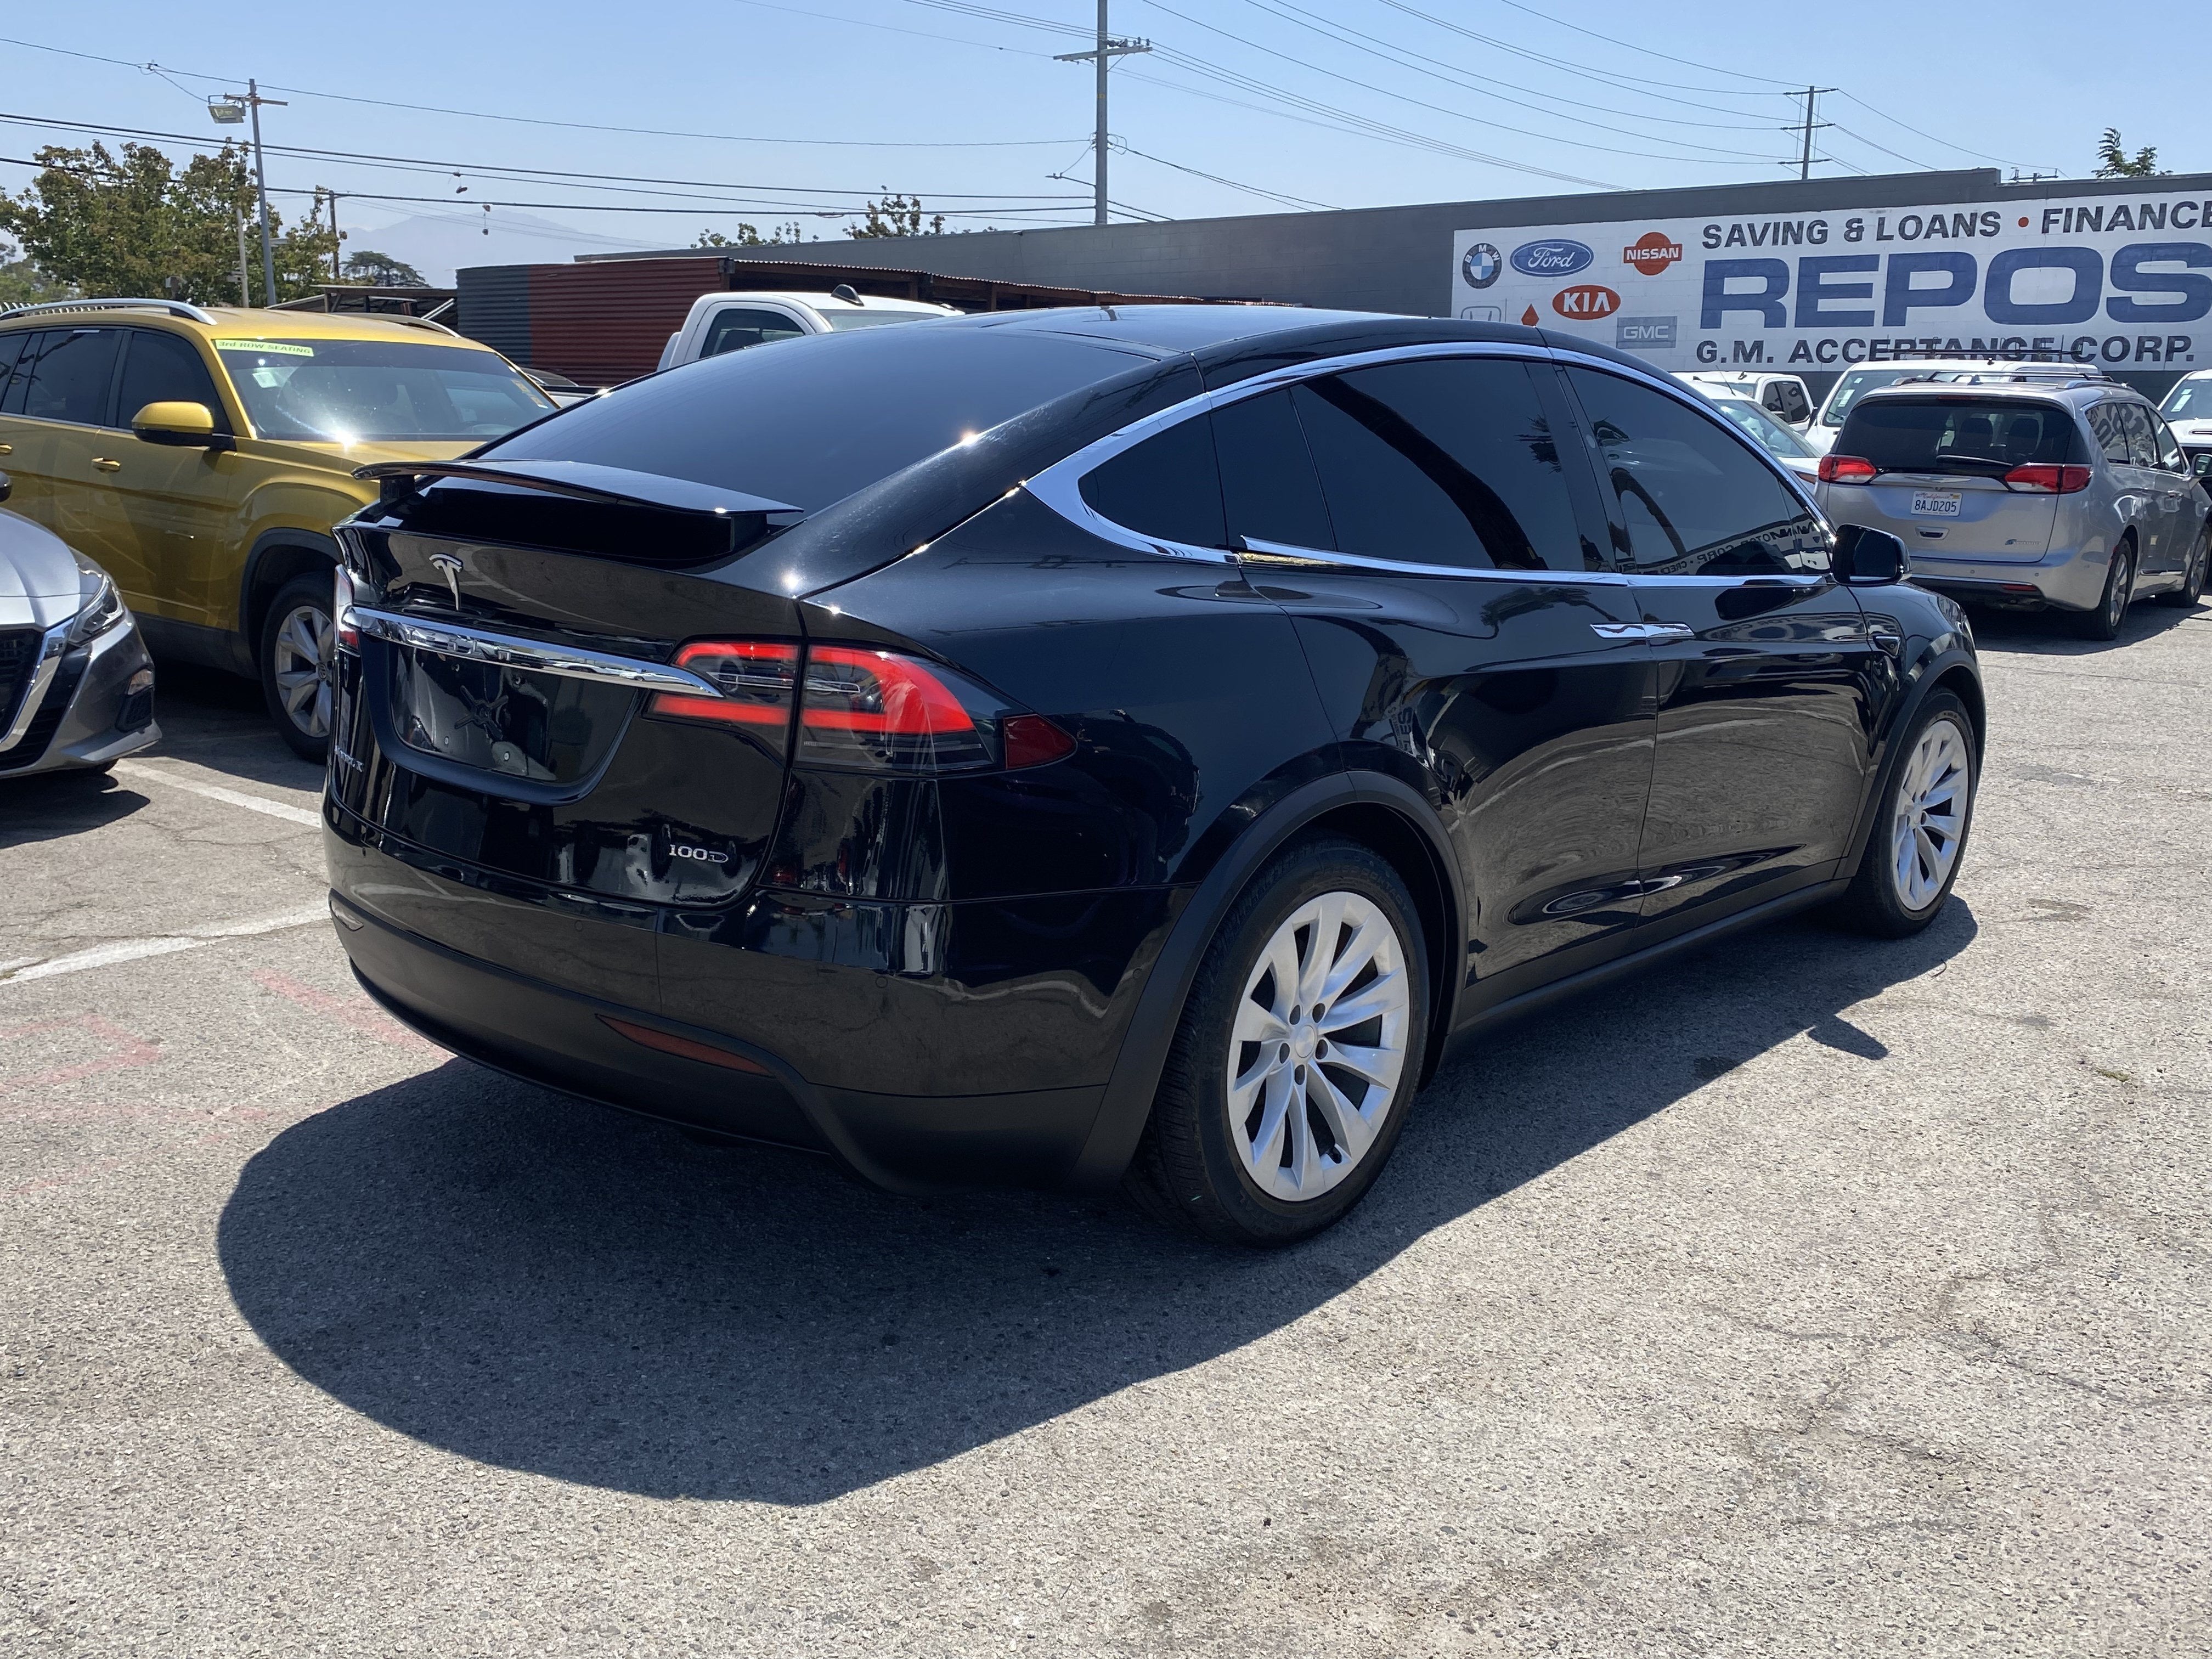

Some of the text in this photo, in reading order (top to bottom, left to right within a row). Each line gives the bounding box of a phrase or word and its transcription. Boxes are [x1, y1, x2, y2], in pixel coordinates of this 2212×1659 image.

[1702, 219, 1829, 249] SAVING
[1843, 218, 1865, 242] &
[1876, 211, 2001, 241] LOANS
[1464, 244, 1501, 264] BMW
[1527, 247, 1576, 268] Ford
[1626, 247, 1679, 261] NISSAN
[1700, 242, 2212, 329] REPOS
[1563, 291, 1611, 313] KIA
[1623, 325, 1669, 339] GMC
[268, 345, 311, 354] SEATING
[1696, 336, 2194, 363] G.M. ACCEPTANCE CORP.
[1915, 500, 1957, 512] 8AJD205
[669, 844, 729, 864] 100D
